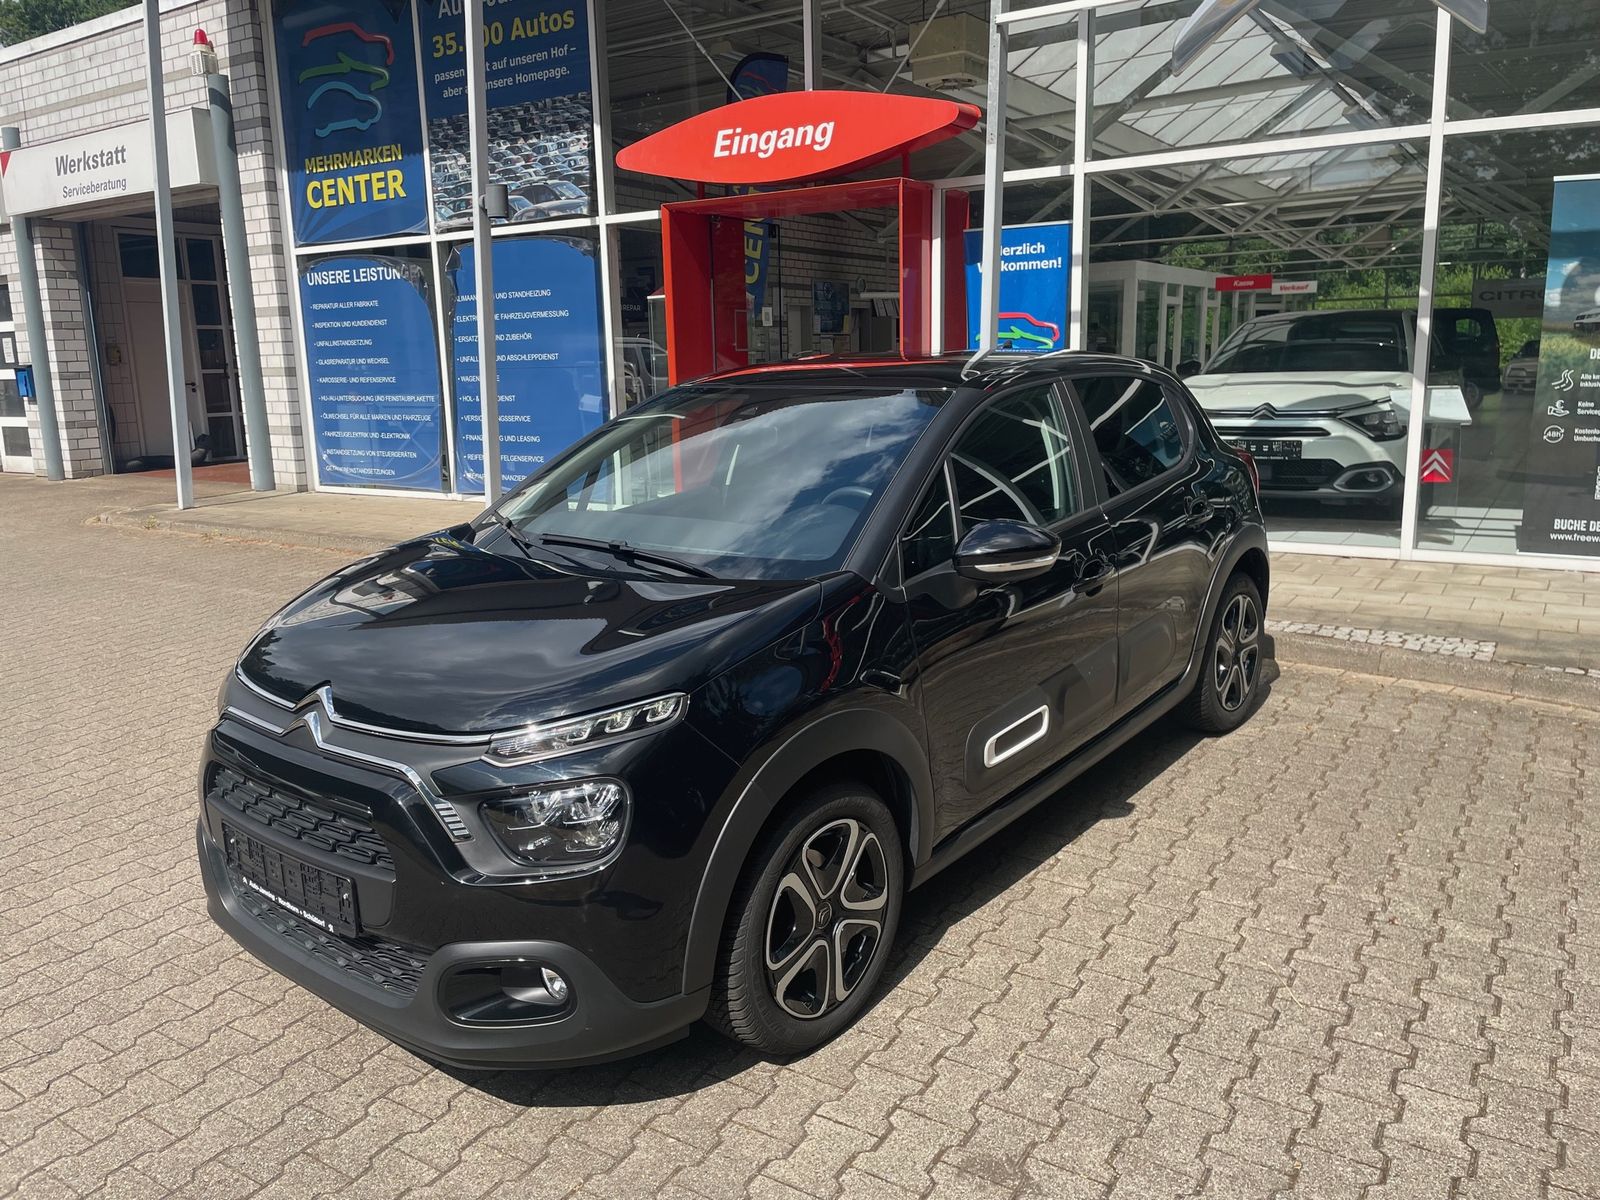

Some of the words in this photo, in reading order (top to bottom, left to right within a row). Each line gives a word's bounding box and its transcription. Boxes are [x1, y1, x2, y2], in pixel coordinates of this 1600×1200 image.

[437, 0, 463, 19] Au
[432, 21, 504, 58] 35.00
[511, 10, 575, 41] Autos
[434, 68, 465, 84] passen
[492, 57, 508, 71] auf
[509, 51, 548, 66] unseren
[550, 44, 569, 58] Hof
[442, 86, 463, 98] aber
[515, 66, 570, 81] Homepage.
[713, 120, 835, 159] Eingang
[55, 144, 127, 177] Werkstatt
[304, 143, 403, 175] MEHRMARKEN
[62, 177, 127, 199] Serviceberatung
[306, 169, 407, 209] CENTER
[977, 256, 1062, 274] kommen!
[306, 269, 351, 286] UNSERE
[353, 264, 414, 283] LEISTUN
[496, 291, 508, 300] UND
[508, 289, 552, 299] STANDHEIZUNG
[1478, 289, 1543, 303] CITR
[312, 302, 339, 310] REPARATUR
[339, 301, 353, 309] ALLER
[353, 300, 379, 308] FABRIKATE
[500, 309, 570, 320] FAHRZEUGVERMESSUNG
[314, 321, 341, 329] INSPEKTION
[341, 320, 352, 328] UND
[352, 319, 388, 327] KUNDENDIENST
[505, 332, 533, 341] ZUBEHÖR
[316, 339, 373, 347] UNFALLINSTANDSETZUNG
[506, 353, 560, 361] ABSCHLEPPDIENST
[360, 376, 397, 384] REIFENSERVICE
[385, 395, 436, 403] FEINSTAUBPLAKETTE
[403, 414, 432, 422] FAHRZEUGE
[324, 431, 369, 439] FAHRZEUGELEKTRIK
[516, 435, 541, 443] LEASING
[326, 448, 366, 457] INSTANDSETZUNG
[467, 453, 485, 461] REIFE
[500, 454, 545, 463] FELGENSERVICE
[1553, 518, 1587, 531] BUCHE
